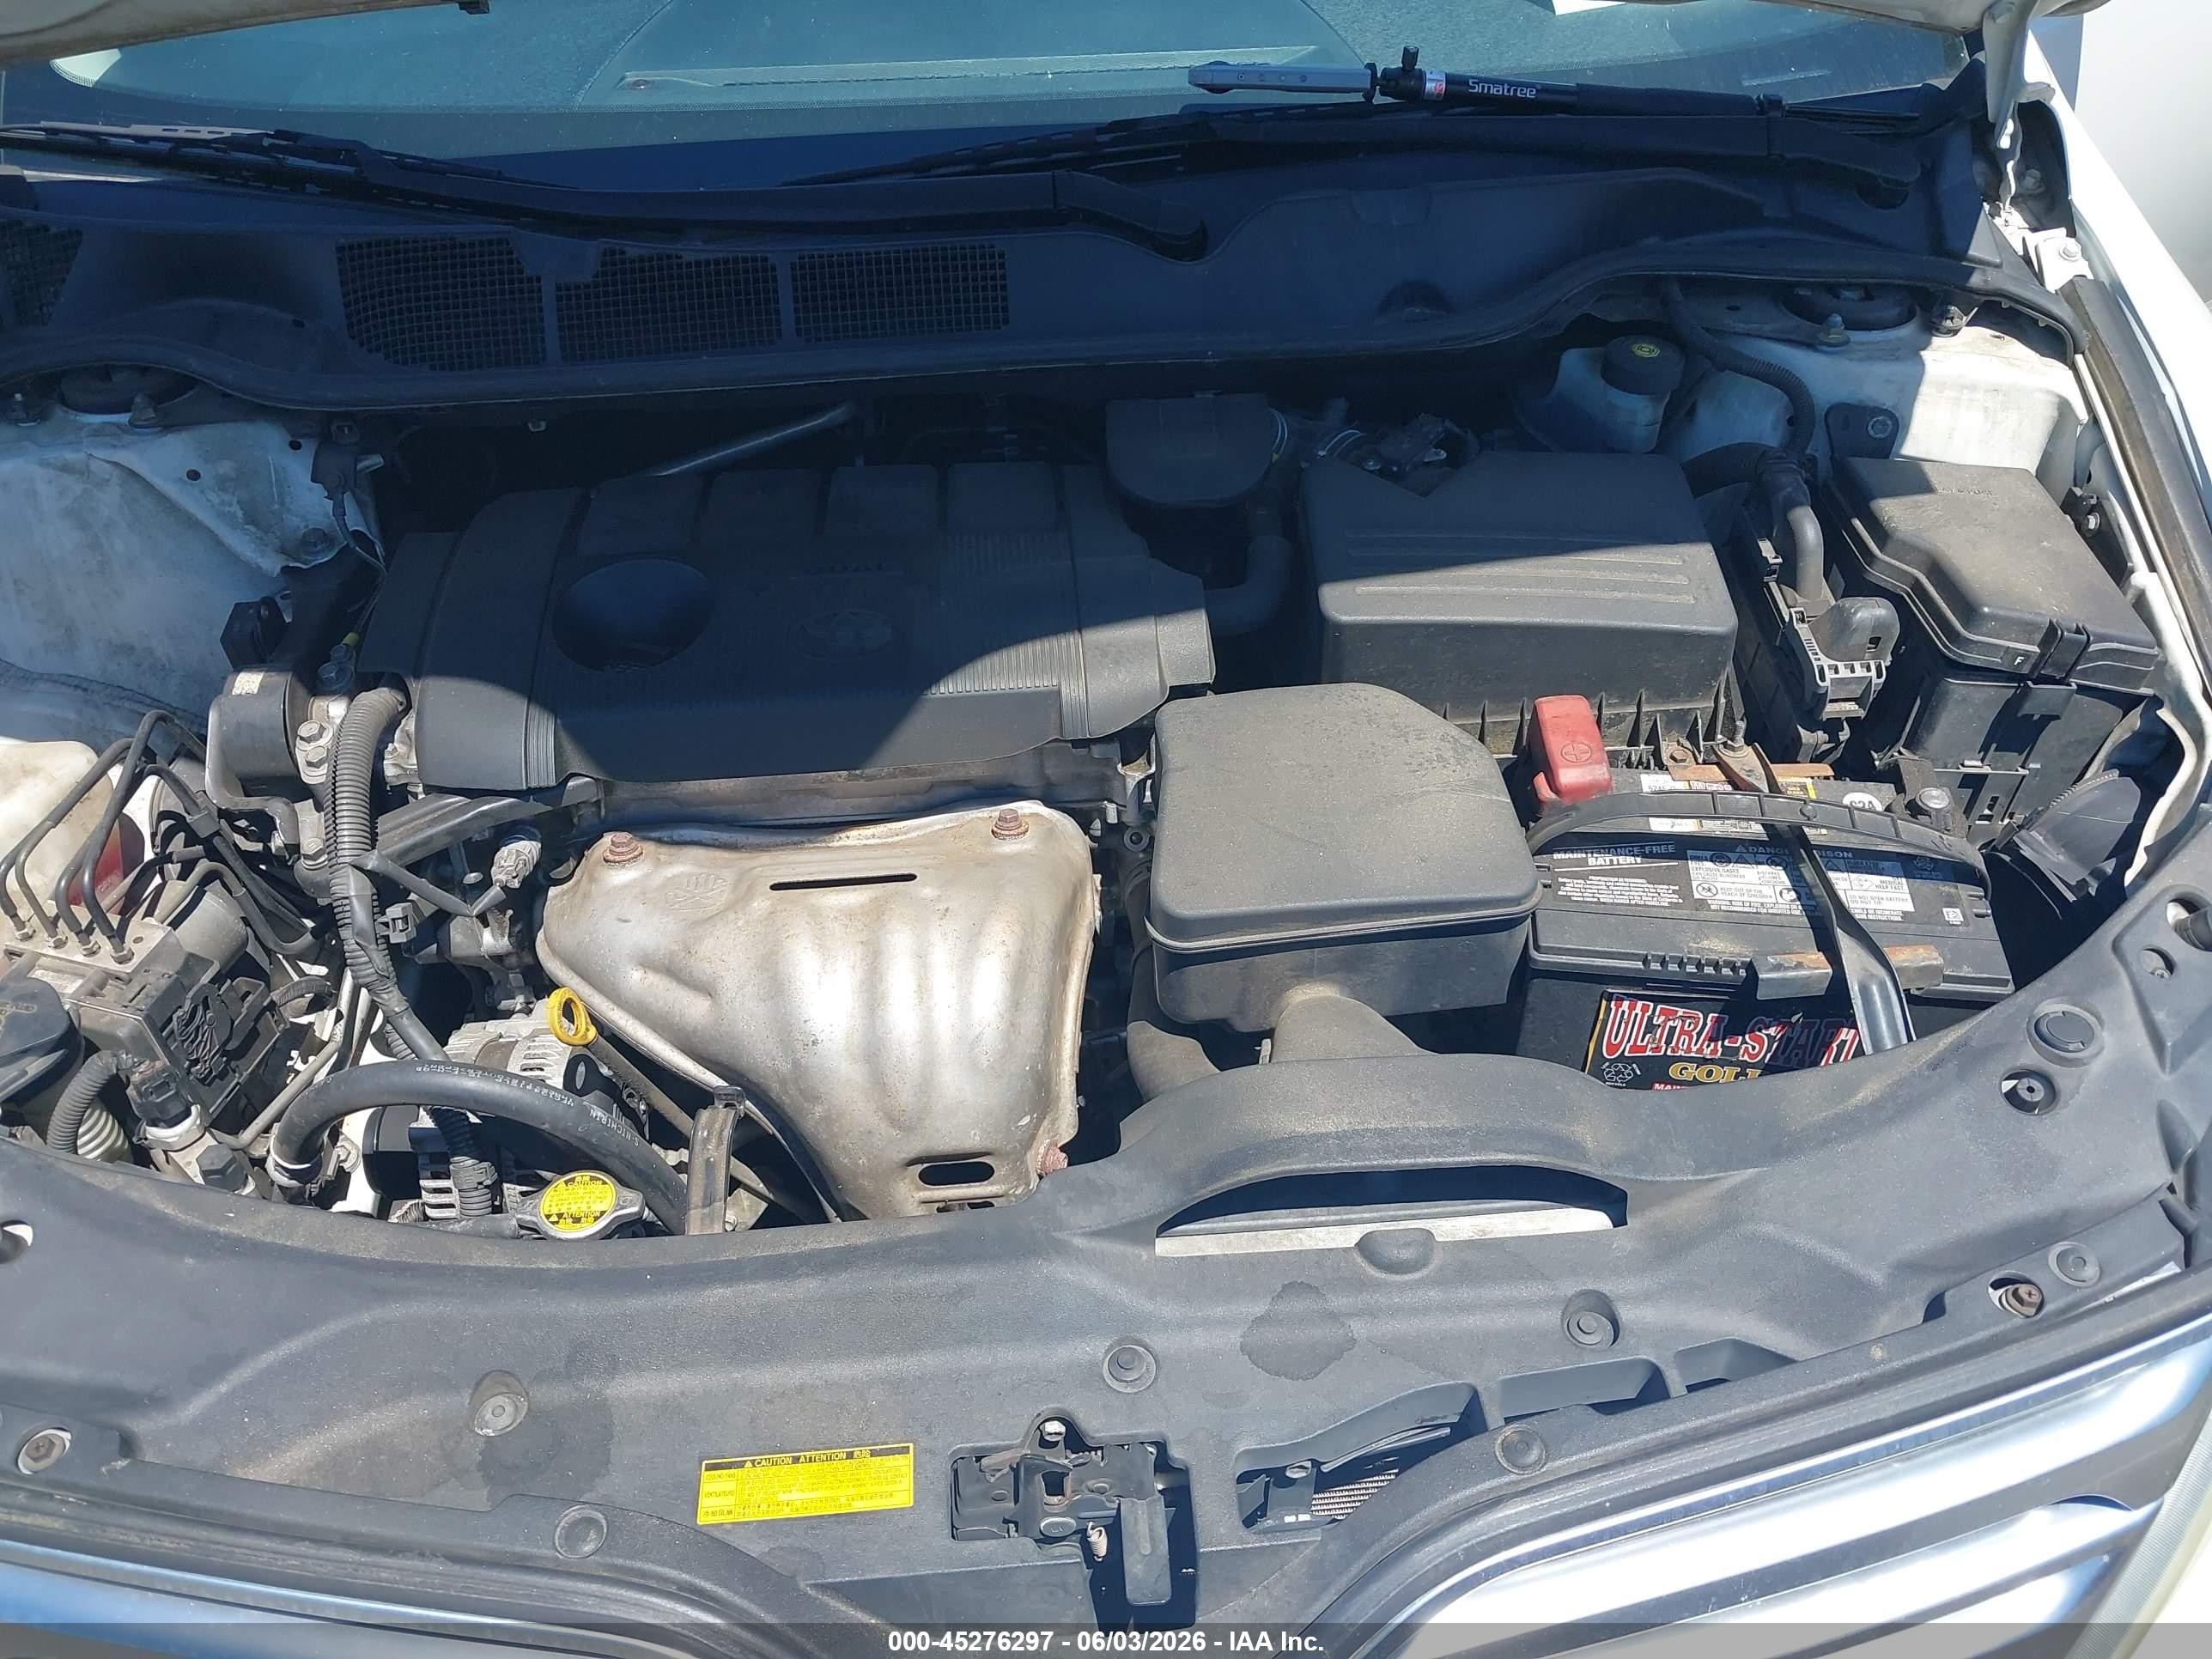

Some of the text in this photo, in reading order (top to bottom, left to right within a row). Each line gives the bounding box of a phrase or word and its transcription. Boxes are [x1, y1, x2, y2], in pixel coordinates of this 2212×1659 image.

[1468, 79, 1536, 98] Smatree
[2014, 656, 2025, 665] F
[1553, 844, 1675, 860] MAINTENANCE-FREE
[1588, 855, 1643, 866] BATTERY
[754, 1451, 847, 1468] CAUTION ATTENTION
